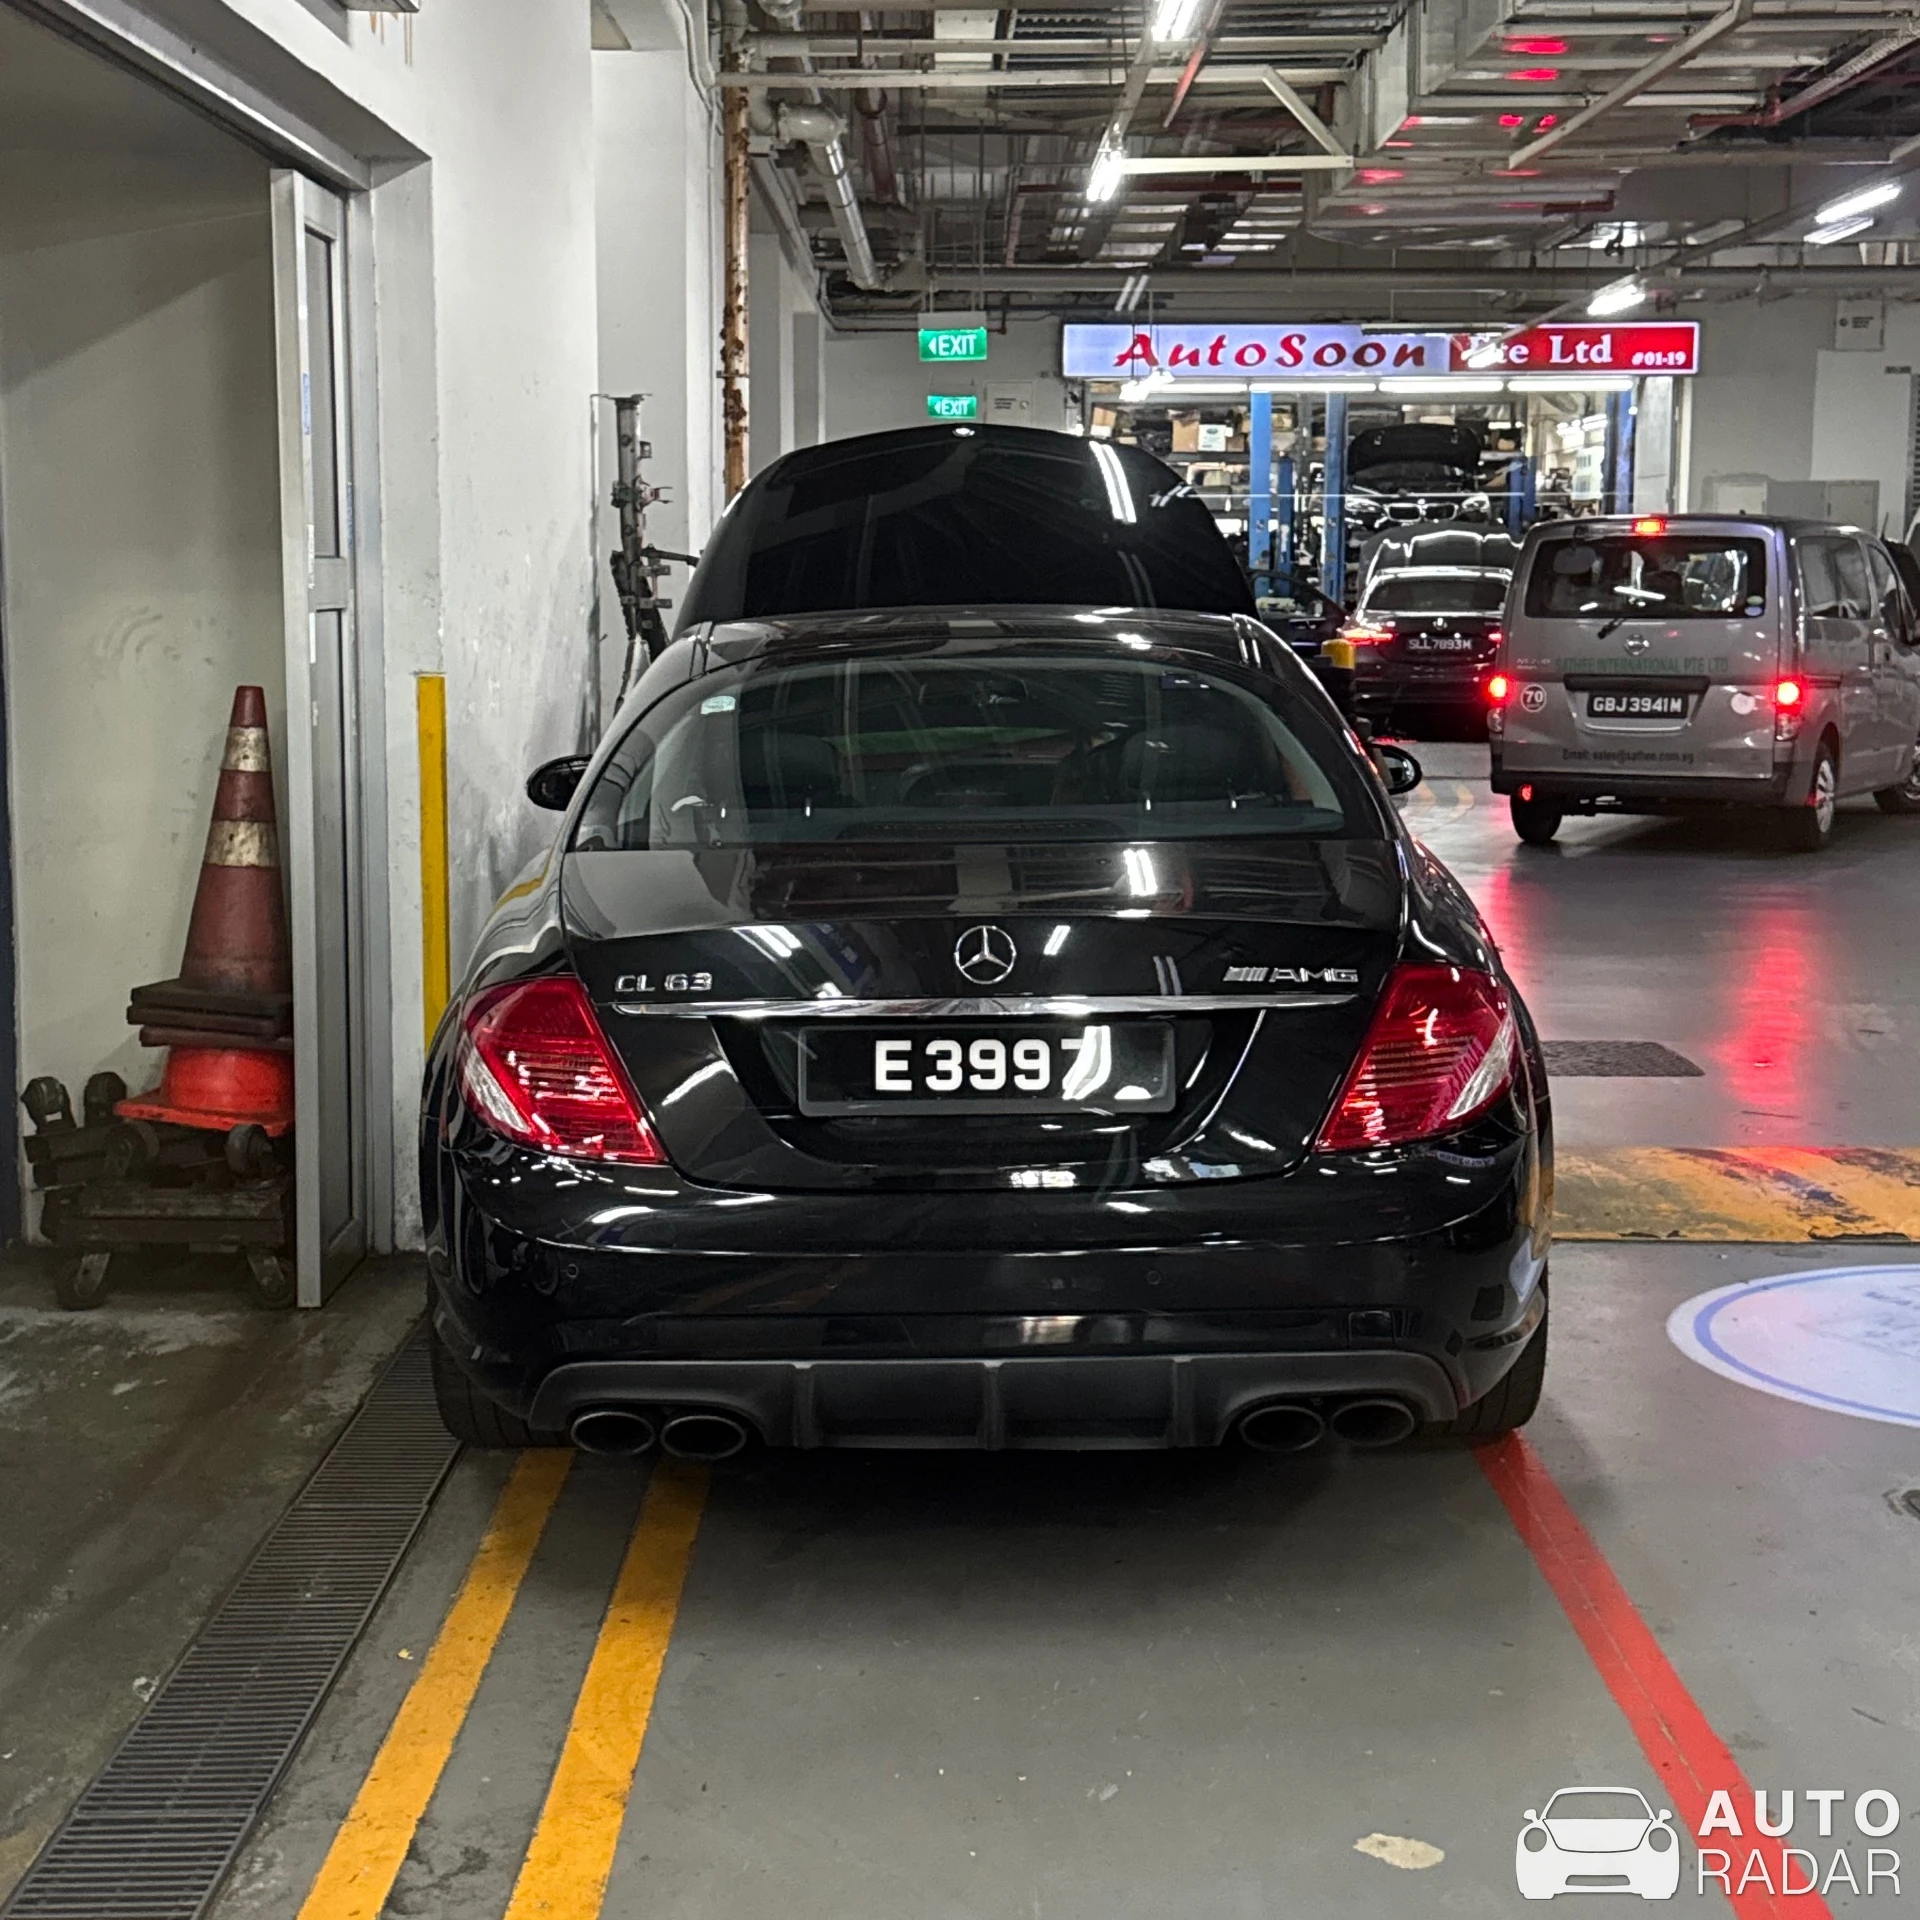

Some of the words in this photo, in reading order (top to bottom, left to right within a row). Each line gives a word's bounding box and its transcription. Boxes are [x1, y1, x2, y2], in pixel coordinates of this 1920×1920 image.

[938, 334, 977, 356] EXIT
[1112, 333, 1425, 368] AutoSoon
[1549, 334, 1613, 364] Ltd
[1631, 351, 1686, 366] #01-19
[942, 399, 971, 415] EXIT
[1596, 657, 1681, 673] INTERNATIONAL
[1684, 657, 1704, 673] PTE
[1708, 657, 1728, 673] LTD
[1524, 690, 1544, 703] 70
[1592, 697, 1683, 712] GBJ3941M
[614, 974, 656, 992] CL
[664, 972, 713, 991] 63
[1268, 967, 1359, 982] AMG
